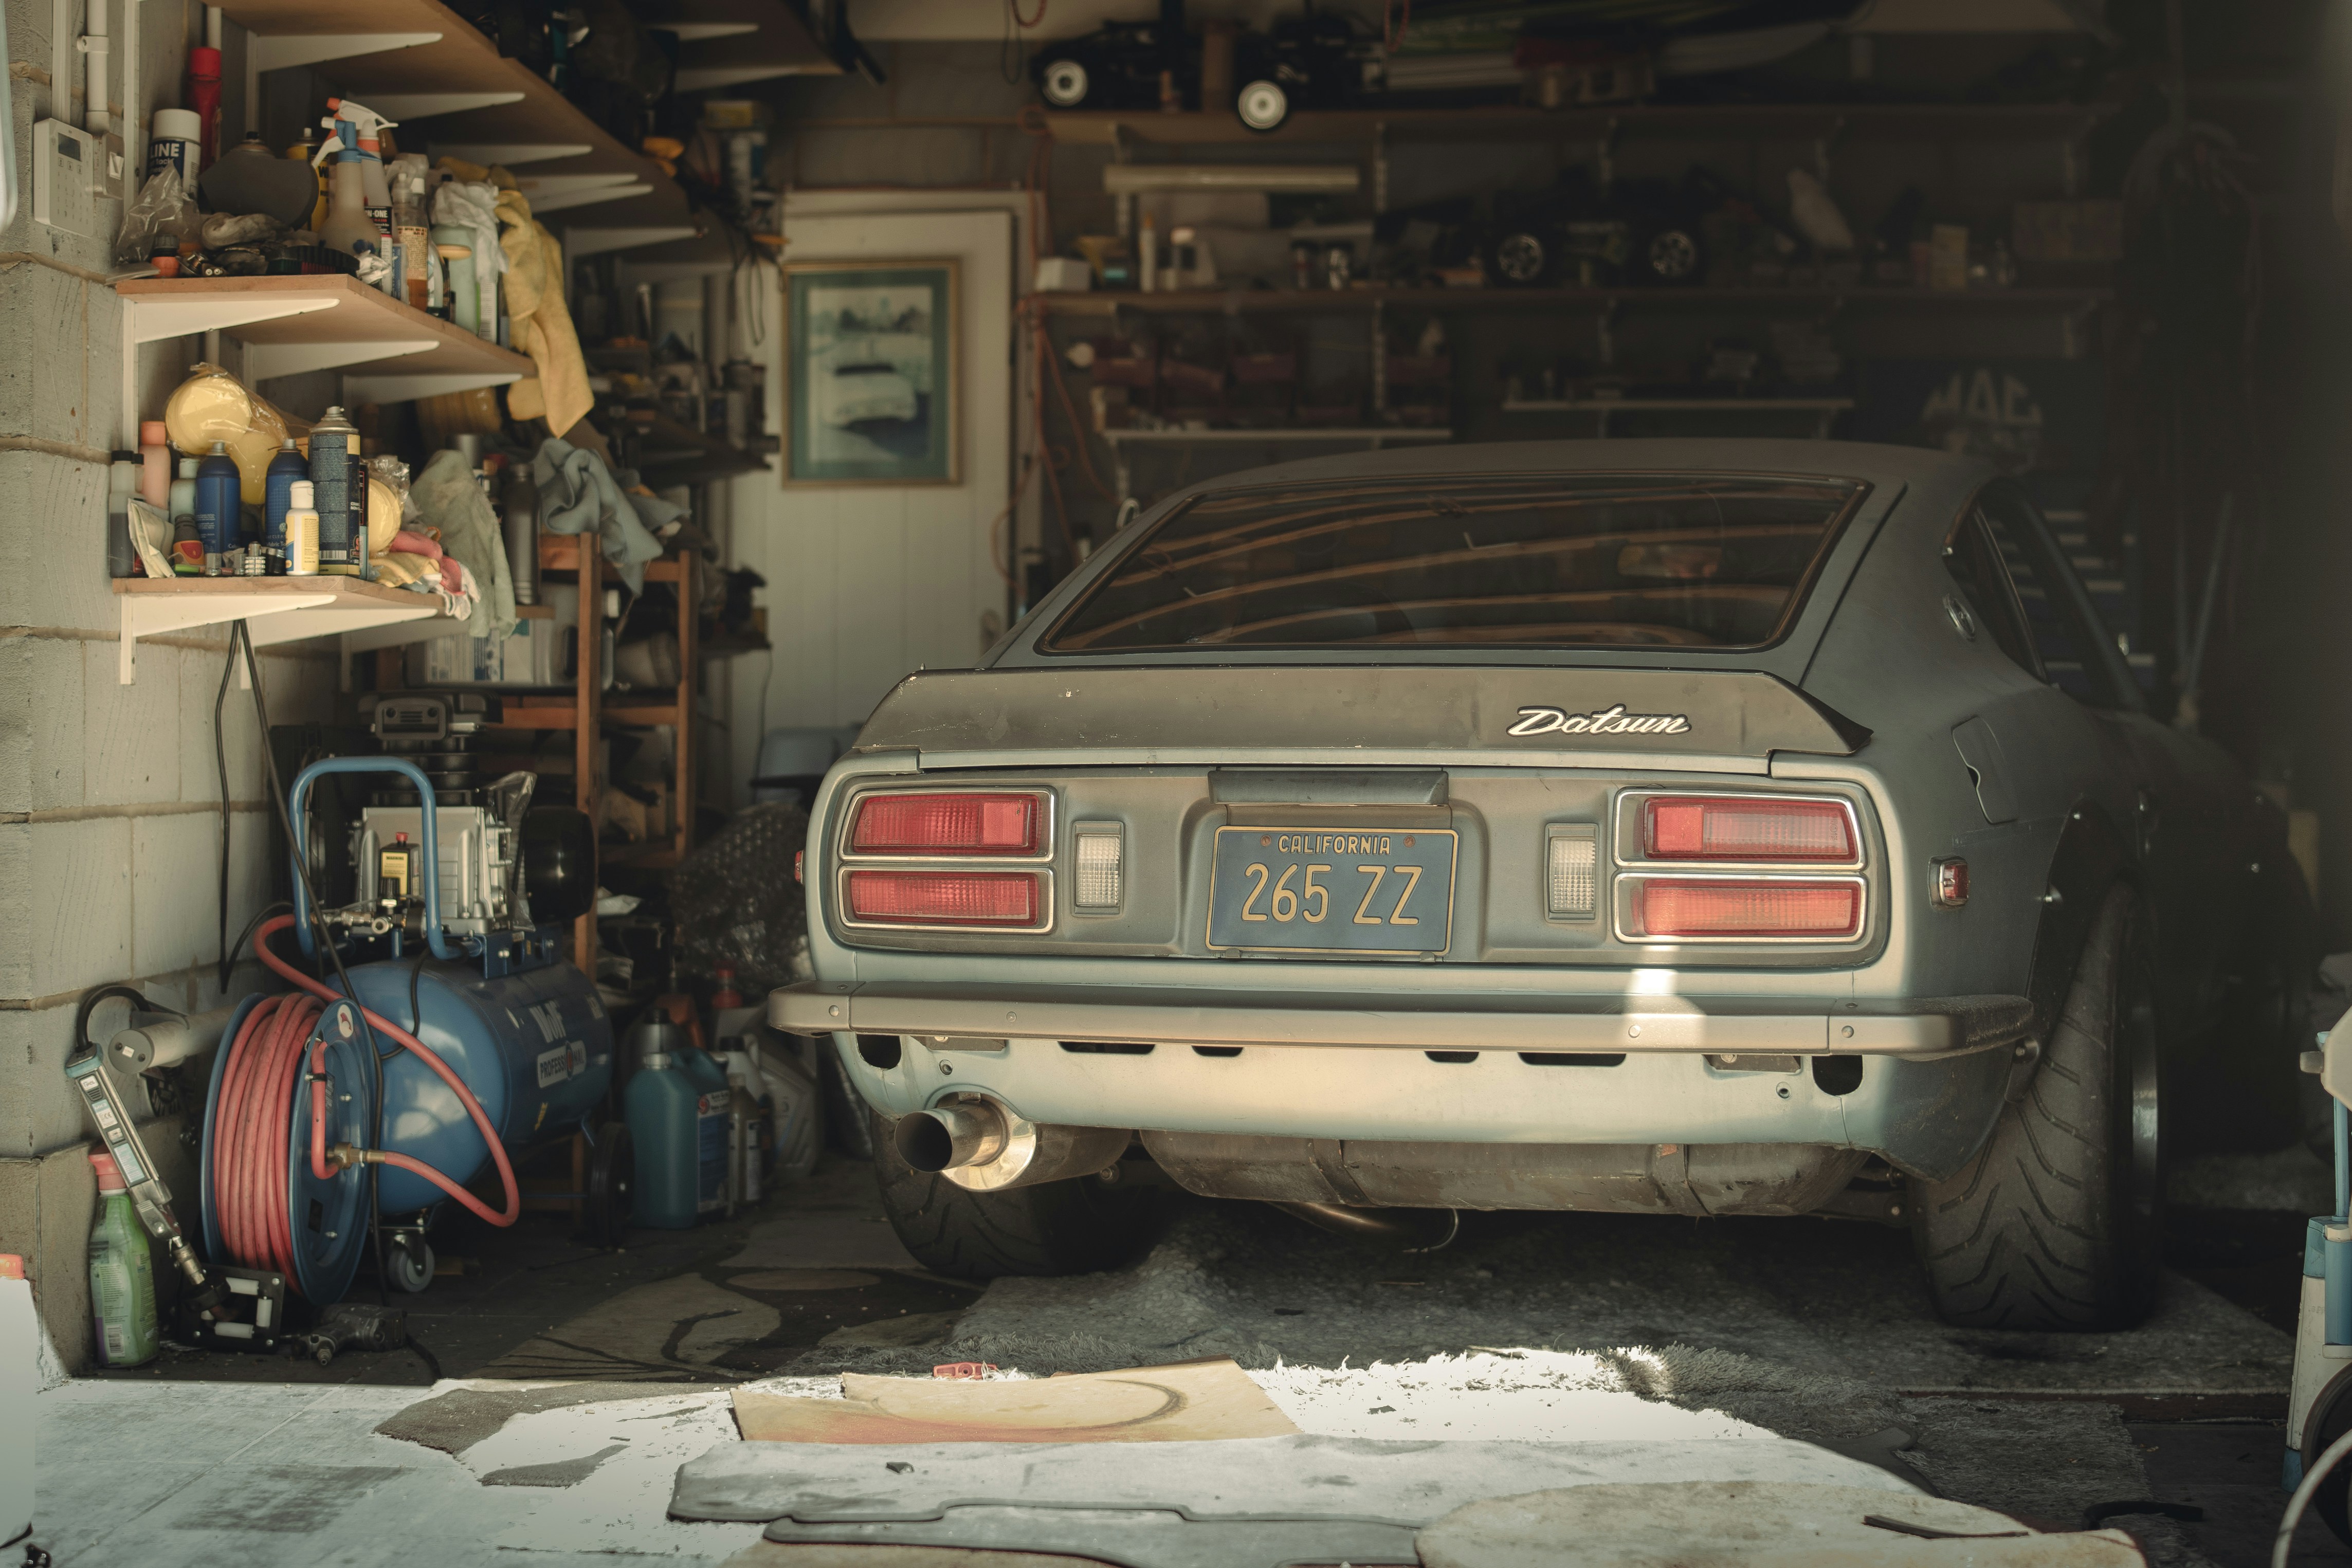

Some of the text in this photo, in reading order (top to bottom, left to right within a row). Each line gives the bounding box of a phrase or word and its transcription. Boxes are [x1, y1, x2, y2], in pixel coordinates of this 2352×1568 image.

[1506, 704, 1691, 736] Datsun
[1279, 835, 1391, 854] CALIFORNIA
[1241, 863, 1423, 925] 265 ZZ
